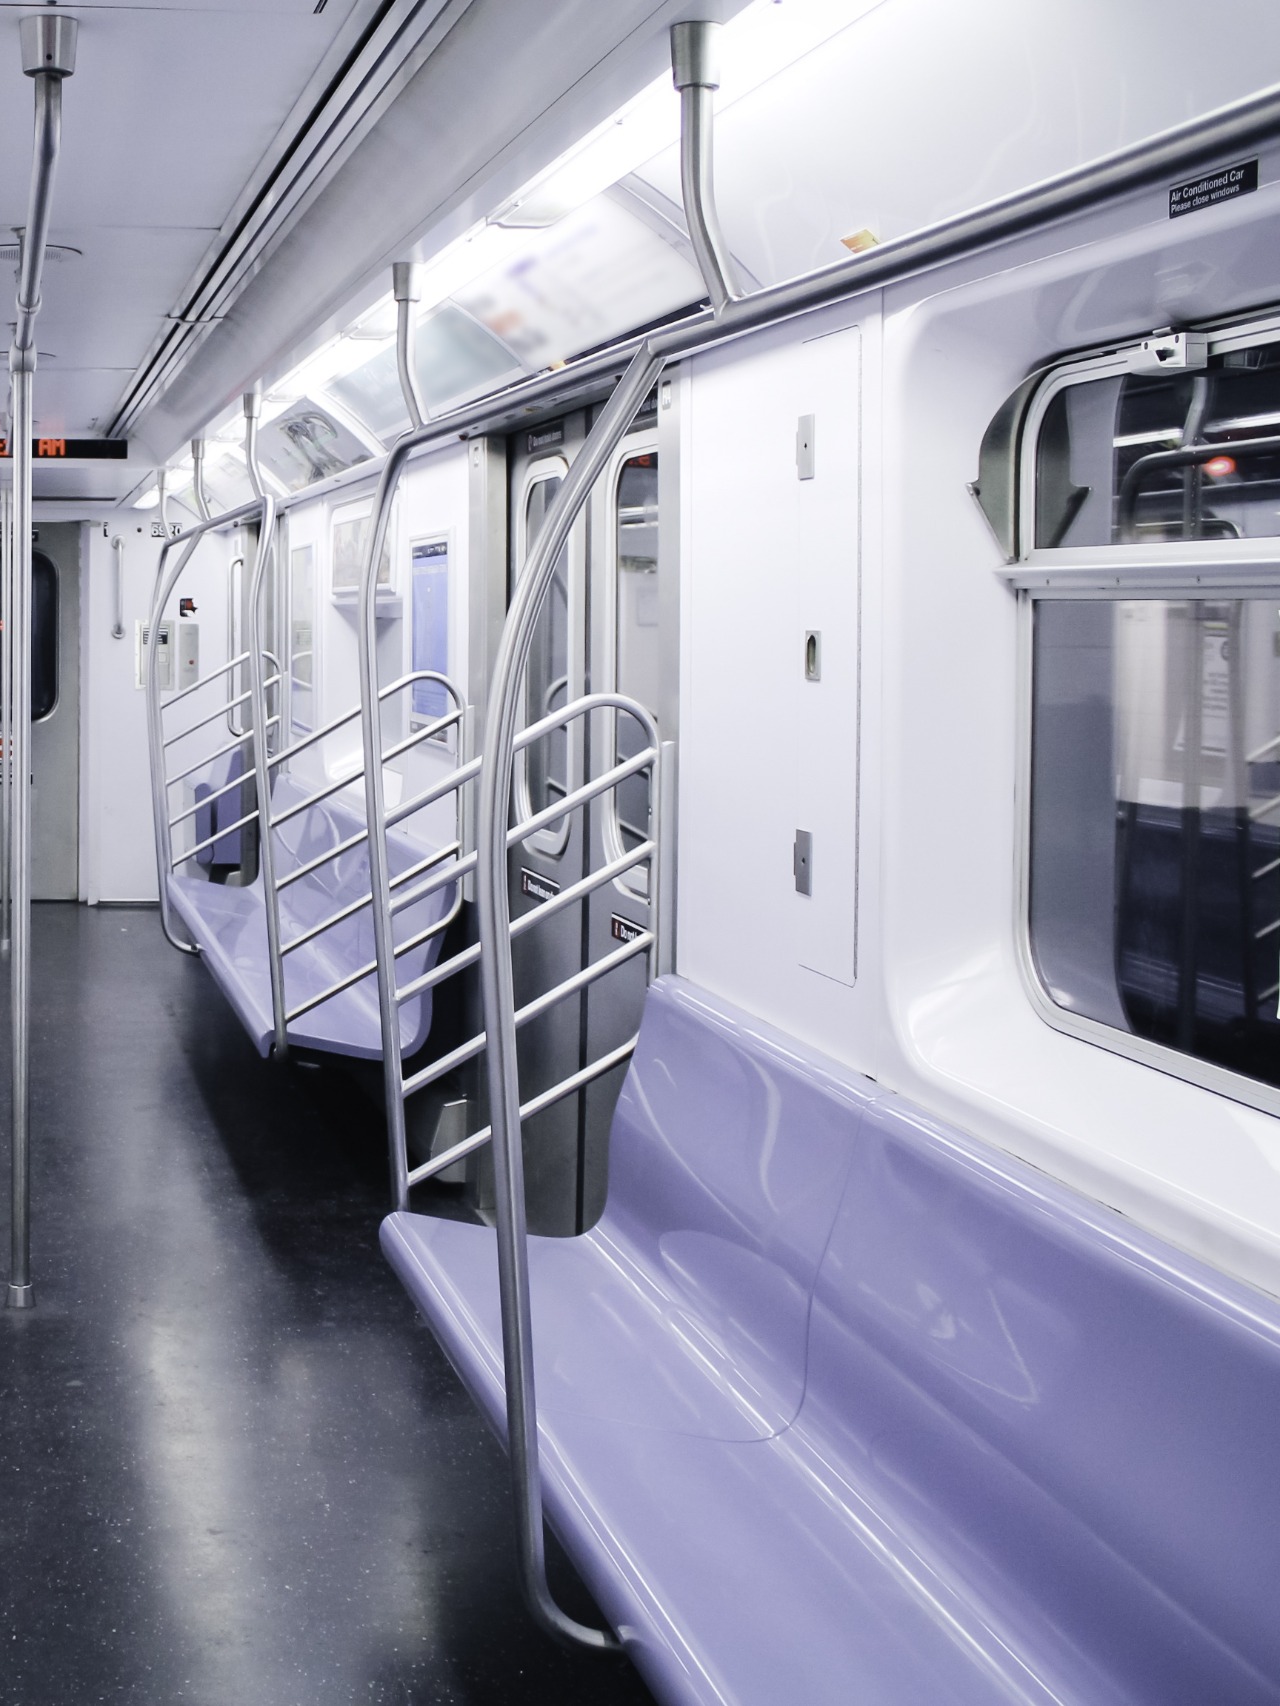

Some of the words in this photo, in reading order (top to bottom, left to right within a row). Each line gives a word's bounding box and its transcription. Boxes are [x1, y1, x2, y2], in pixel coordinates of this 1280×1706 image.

[1171, 189, 1182, 203] Air
[1183, 172, 1228, 198] Conditioned
[1229, 169, 1245, 182] Car
[1171, 200, 1191, 214] Please
[1192, 194, 1209, 207] close
[1210, 183, 1240, 200] windows
[38, 438, 65, 456] AM
[621, 924, 627, 940] Do
